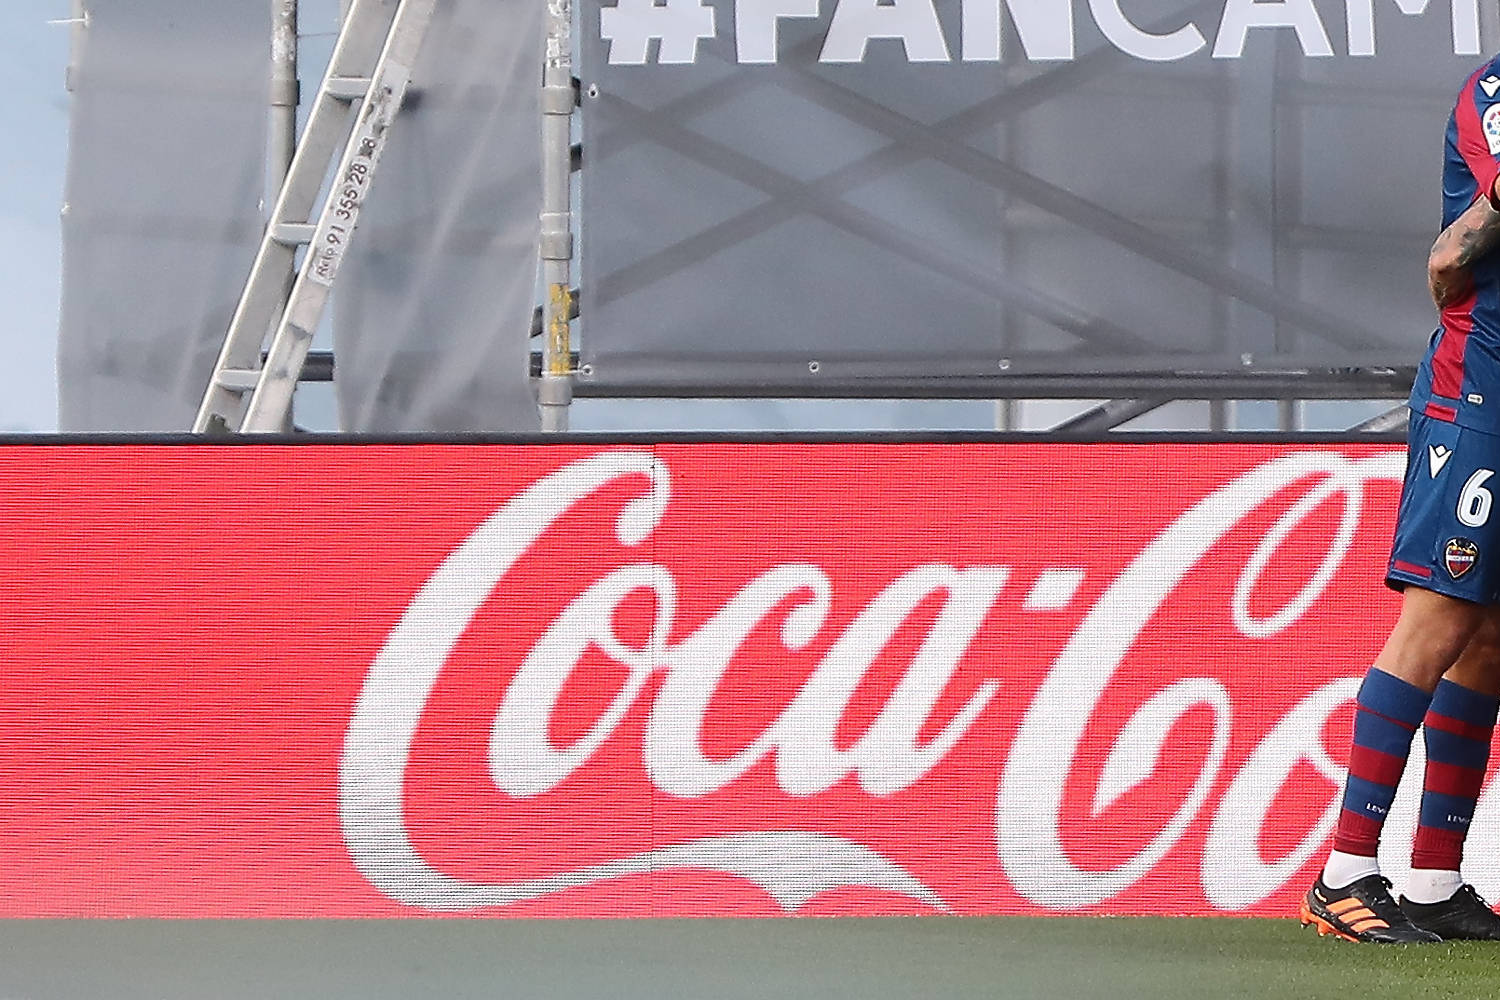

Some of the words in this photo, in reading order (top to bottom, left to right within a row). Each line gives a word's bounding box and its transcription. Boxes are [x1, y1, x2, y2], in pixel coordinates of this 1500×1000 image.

[336, 188, 359, 221] 355
[350, 163, 368, 186] 28
[1456, 468, 1496, 528] 6
